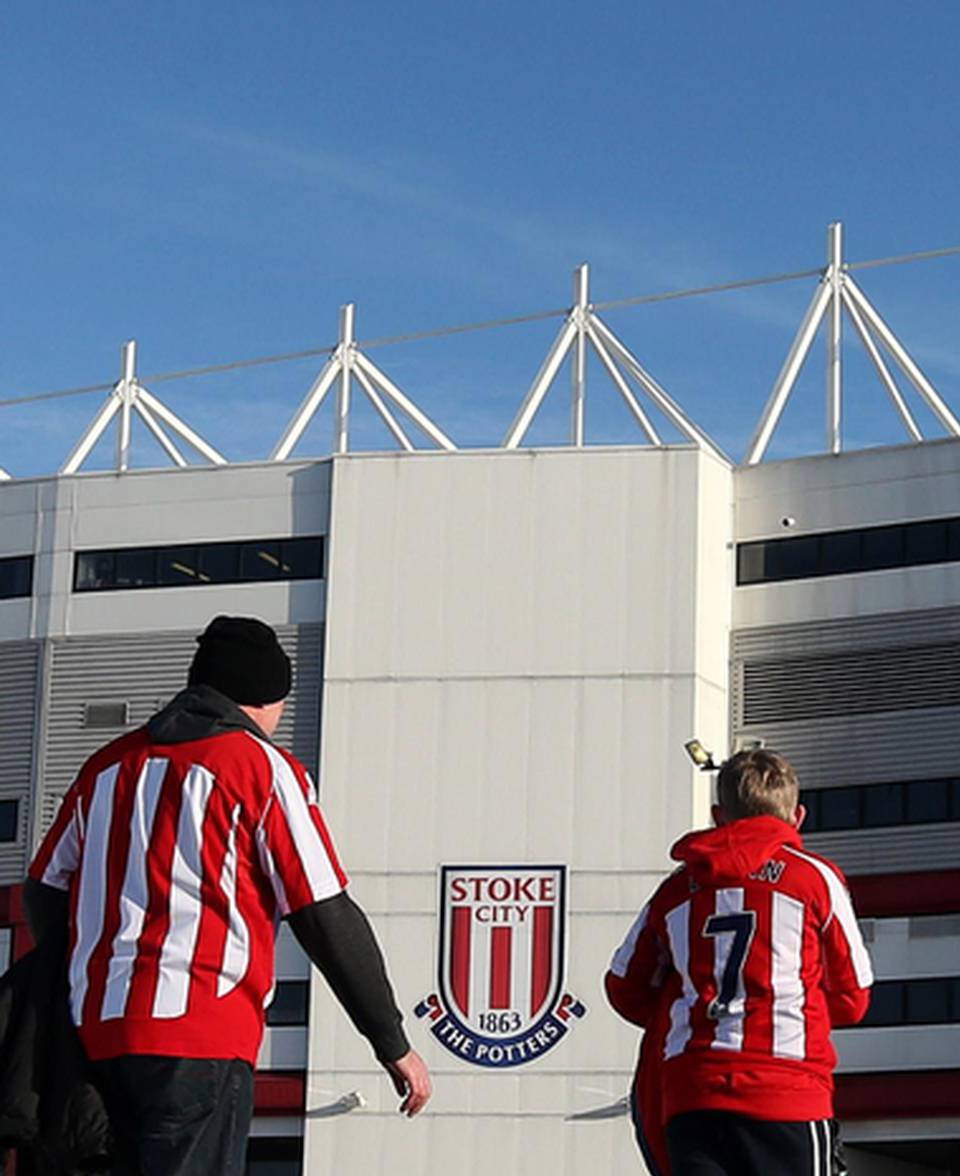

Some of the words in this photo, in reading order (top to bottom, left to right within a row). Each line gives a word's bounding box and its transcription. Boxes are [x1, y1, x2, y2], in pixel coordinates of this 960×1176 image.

[450, 877, 556, 902] STOKE
[475, 905, 531, 922] CITY
[702, 911, 757, 1019] 7
[478, 1011, 522, 1033] 1863
[439, 1021, 471, 1055] THE
[475, 1021, 559, 1063] POTTERS
